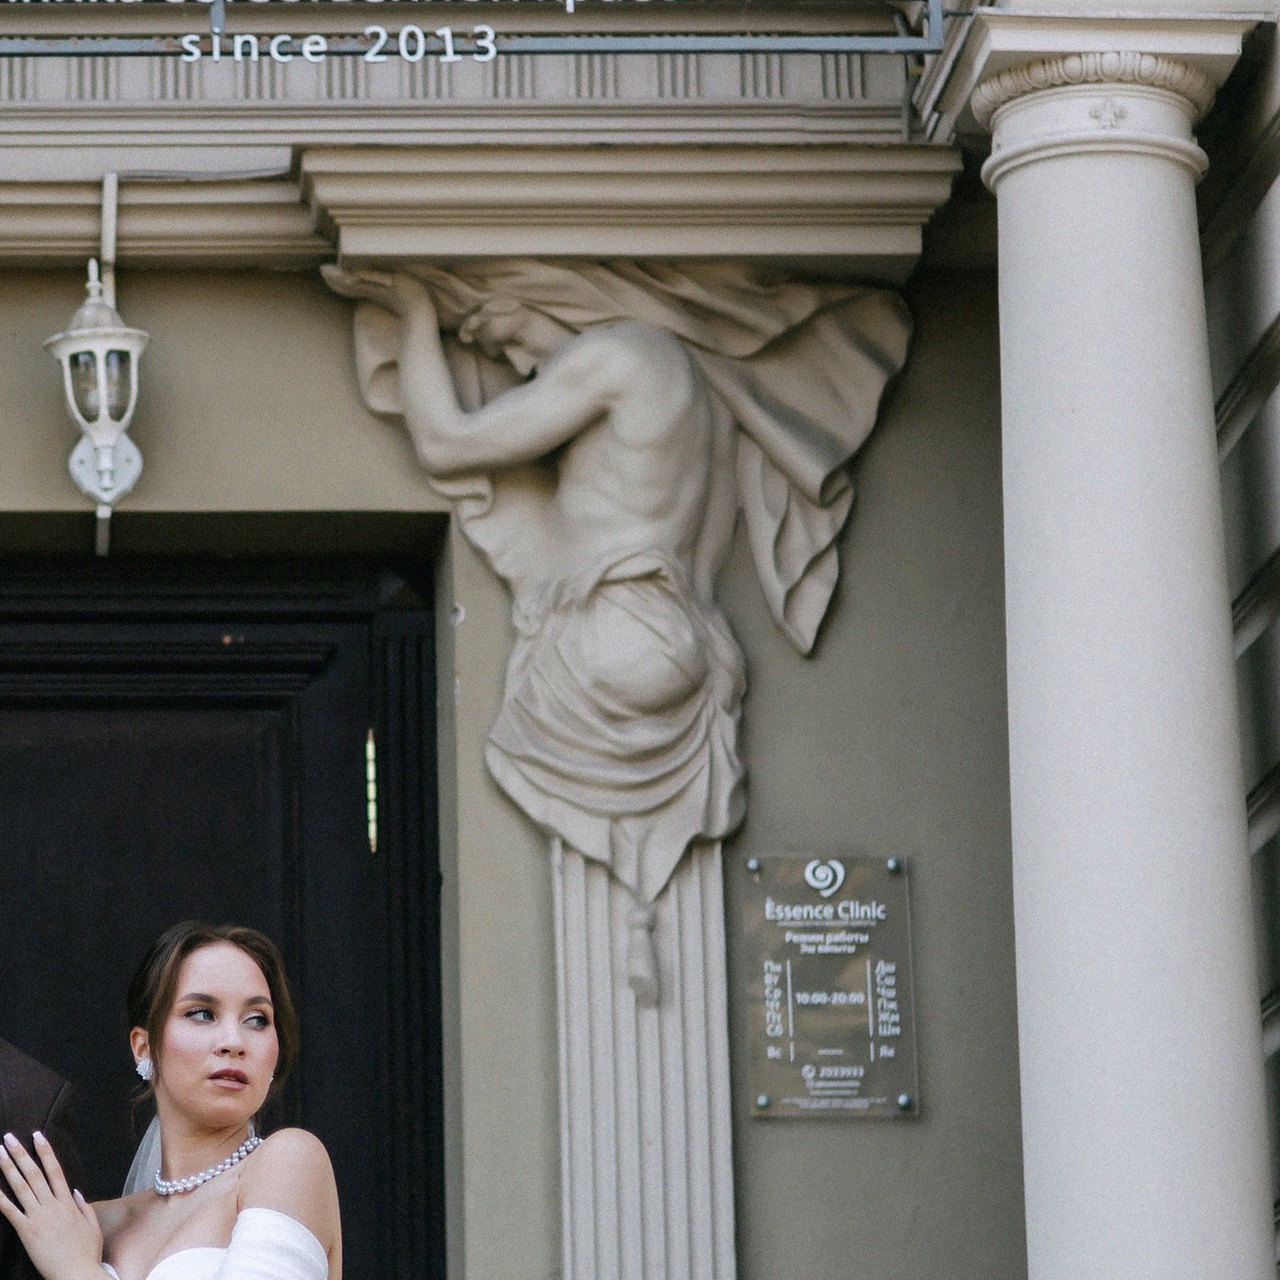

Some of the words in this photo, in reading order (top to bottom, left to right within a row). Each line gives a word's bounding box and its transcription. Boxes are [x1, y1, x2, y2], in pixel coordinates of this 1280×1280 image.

[179, 27, 329, 64] since
[363, 24, 498, 64] 2013
[837, 900, 887, 921] Clinic
